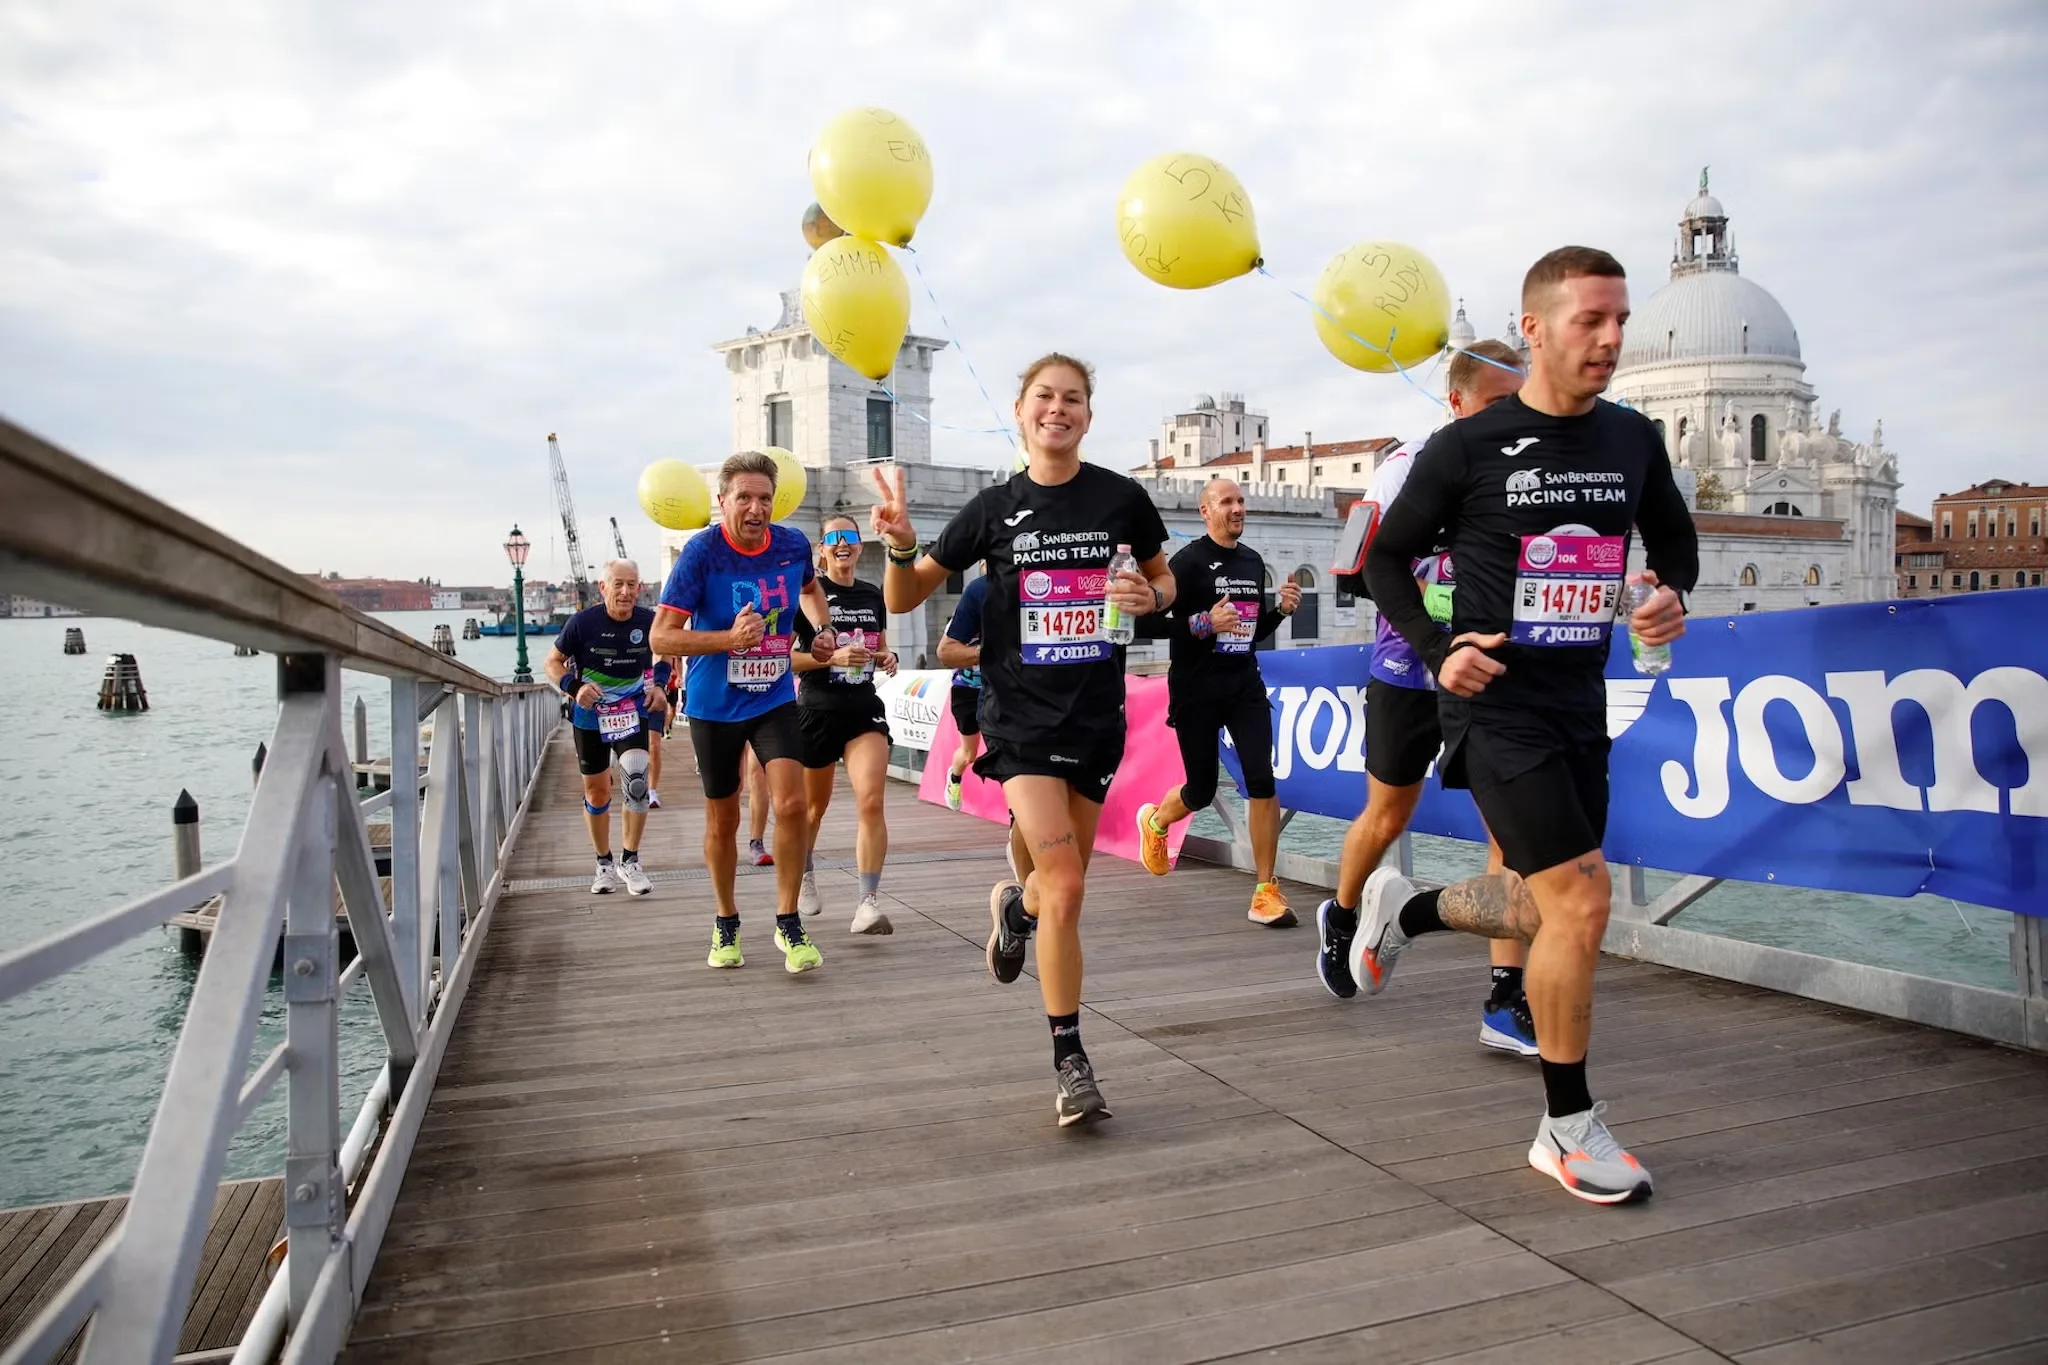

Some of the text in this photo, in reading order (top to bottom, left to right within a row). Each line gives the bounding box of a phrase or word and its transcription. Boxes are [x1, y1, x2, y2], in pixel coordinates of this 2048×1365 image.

[818, 250, 883, 285] EMMA
[1372, 260, 1429, 318] RUDY
[1506, 488, 1626, 508] PACING TEAM
[1013, 546, 1110, 566] PACING TEAM
[1558, 554, 1578, 564] 10K
[1053, 585, 1072, 594] 10K
[1542, 584, 1602, 614] 14715
[1043, 609, 1096, 636] 14723
[1546, 626, 1601, 643] Joma
[1051, 644, 1101, 661] Joma
[742, 661, 777, 677] 14140
